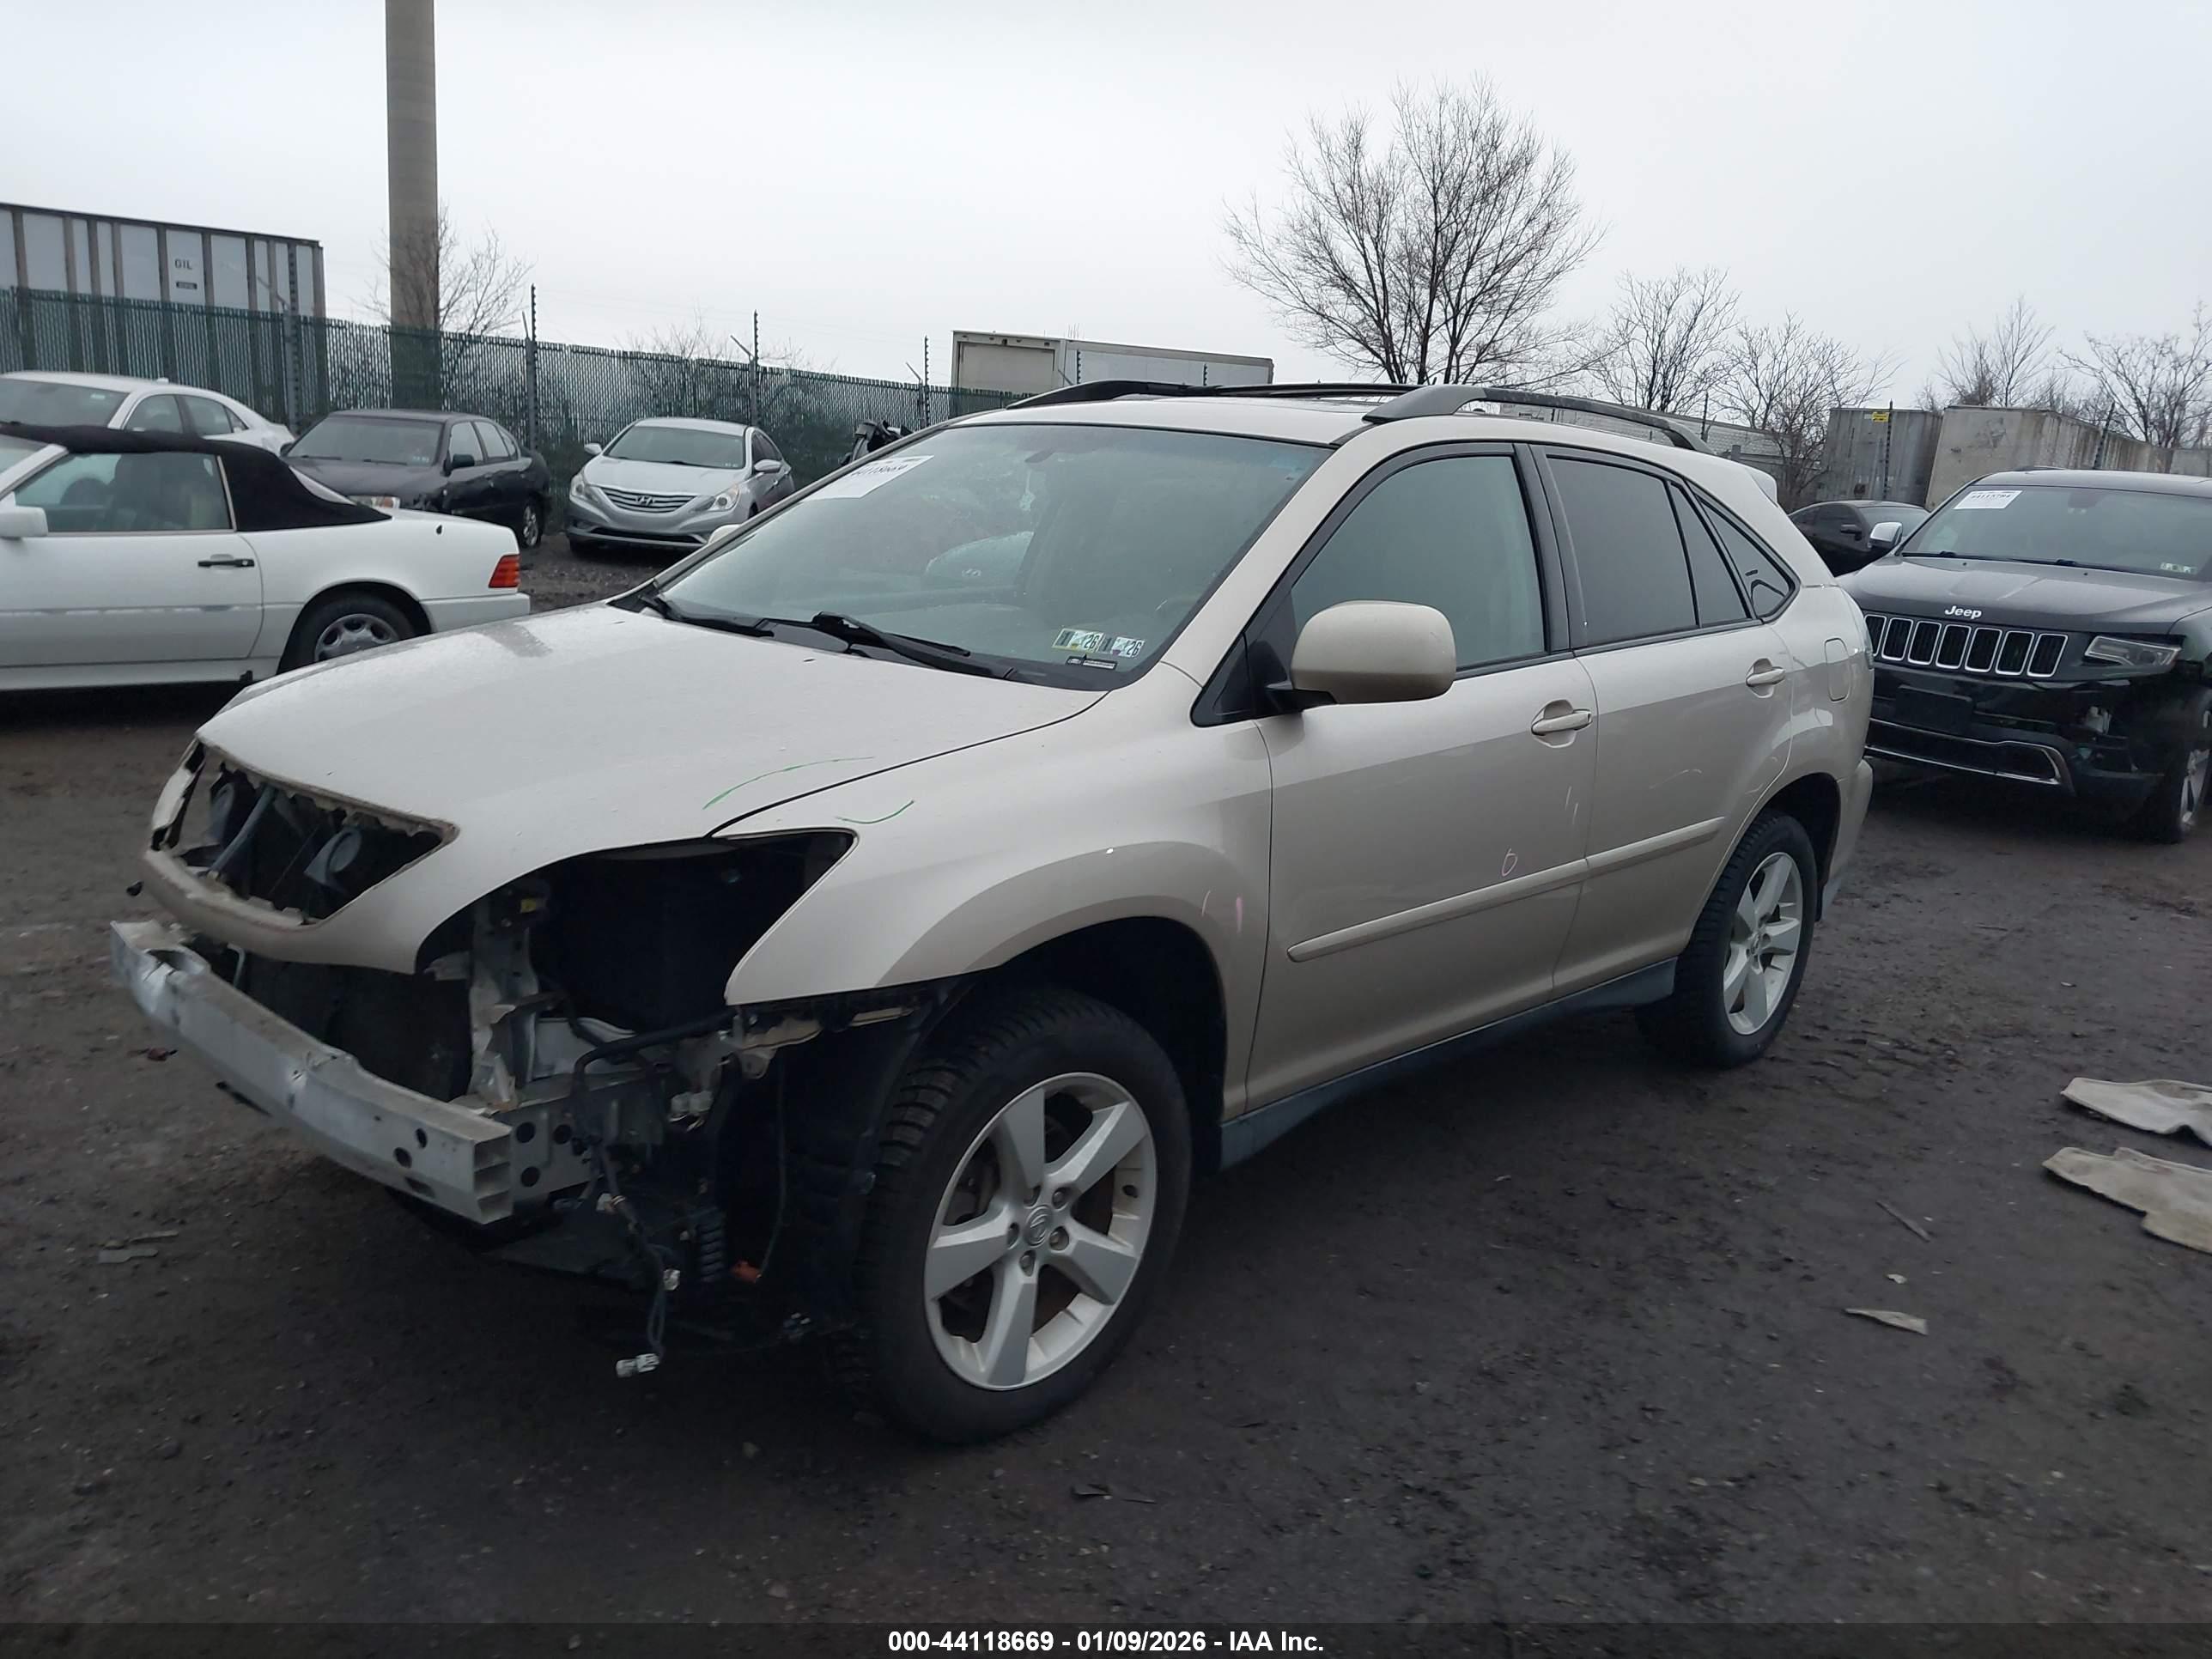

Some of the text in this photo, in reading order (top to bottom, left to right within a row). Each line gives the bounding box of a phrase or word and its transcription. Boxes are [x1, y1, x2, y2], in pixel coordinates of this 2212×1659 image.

[1944, 605, 1982, 619] Jeep
[1084, 635, 1100, 650] 26
[1126, 640, 1143, 656] 26
